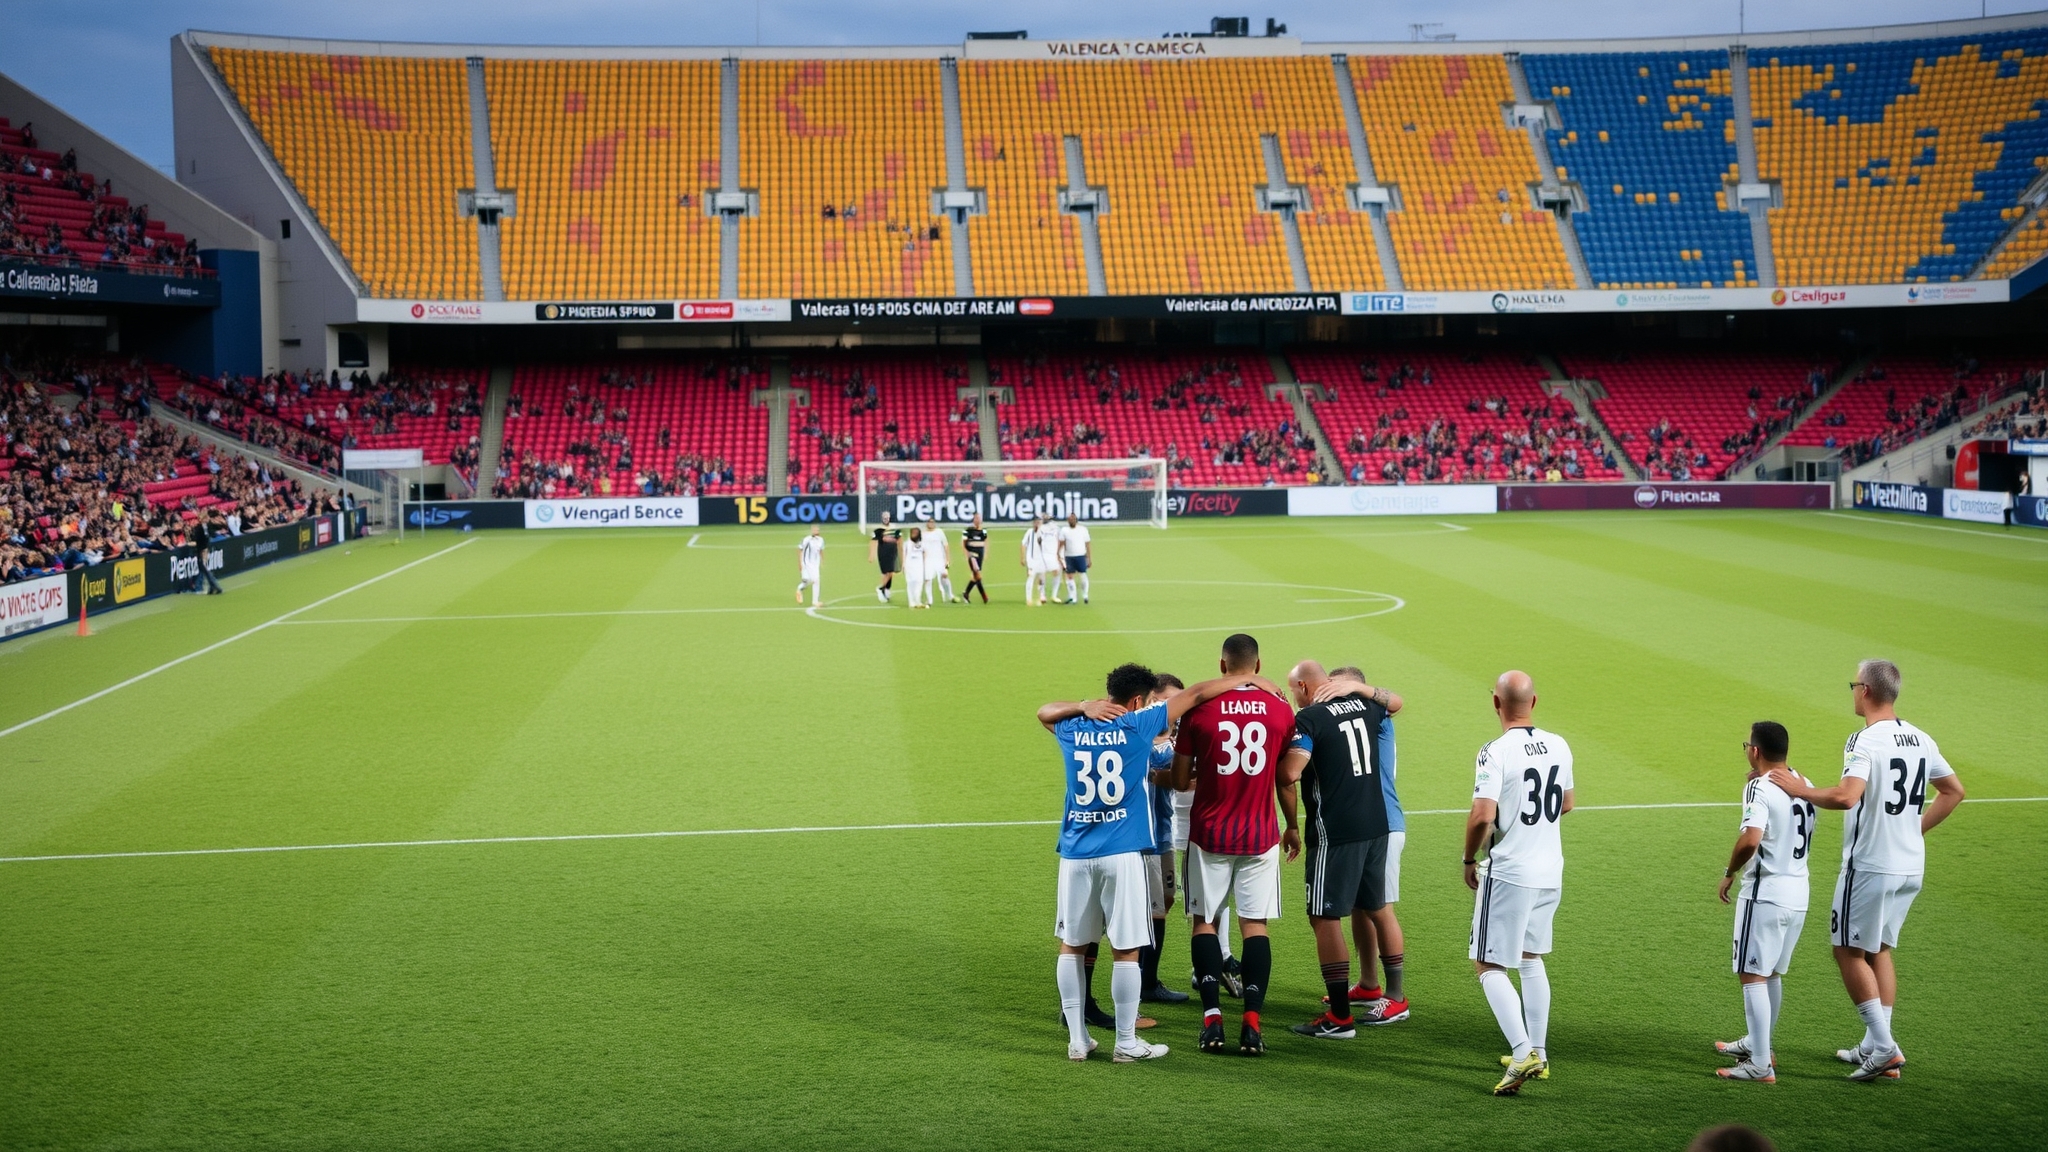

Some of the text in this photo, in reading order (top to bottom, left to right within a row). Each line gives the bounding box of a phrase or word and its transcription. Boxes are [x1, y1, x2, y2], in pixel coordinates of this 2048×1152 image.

[735, 497, 849, 524] 15 Gove
[896, 493, 984, 522] Pertel
[1220, 700, 1267, 715] LEADER
[1073, 729, 1127, 746] VALESIA
[1216, 720, 1267, 776] 38
[1338, 717, 1372, 776] 11
[1073, 750, 1125, 806] 38
[1520, 765, 1563, 826] 36
[1885, 757, 1926, 816] 34
